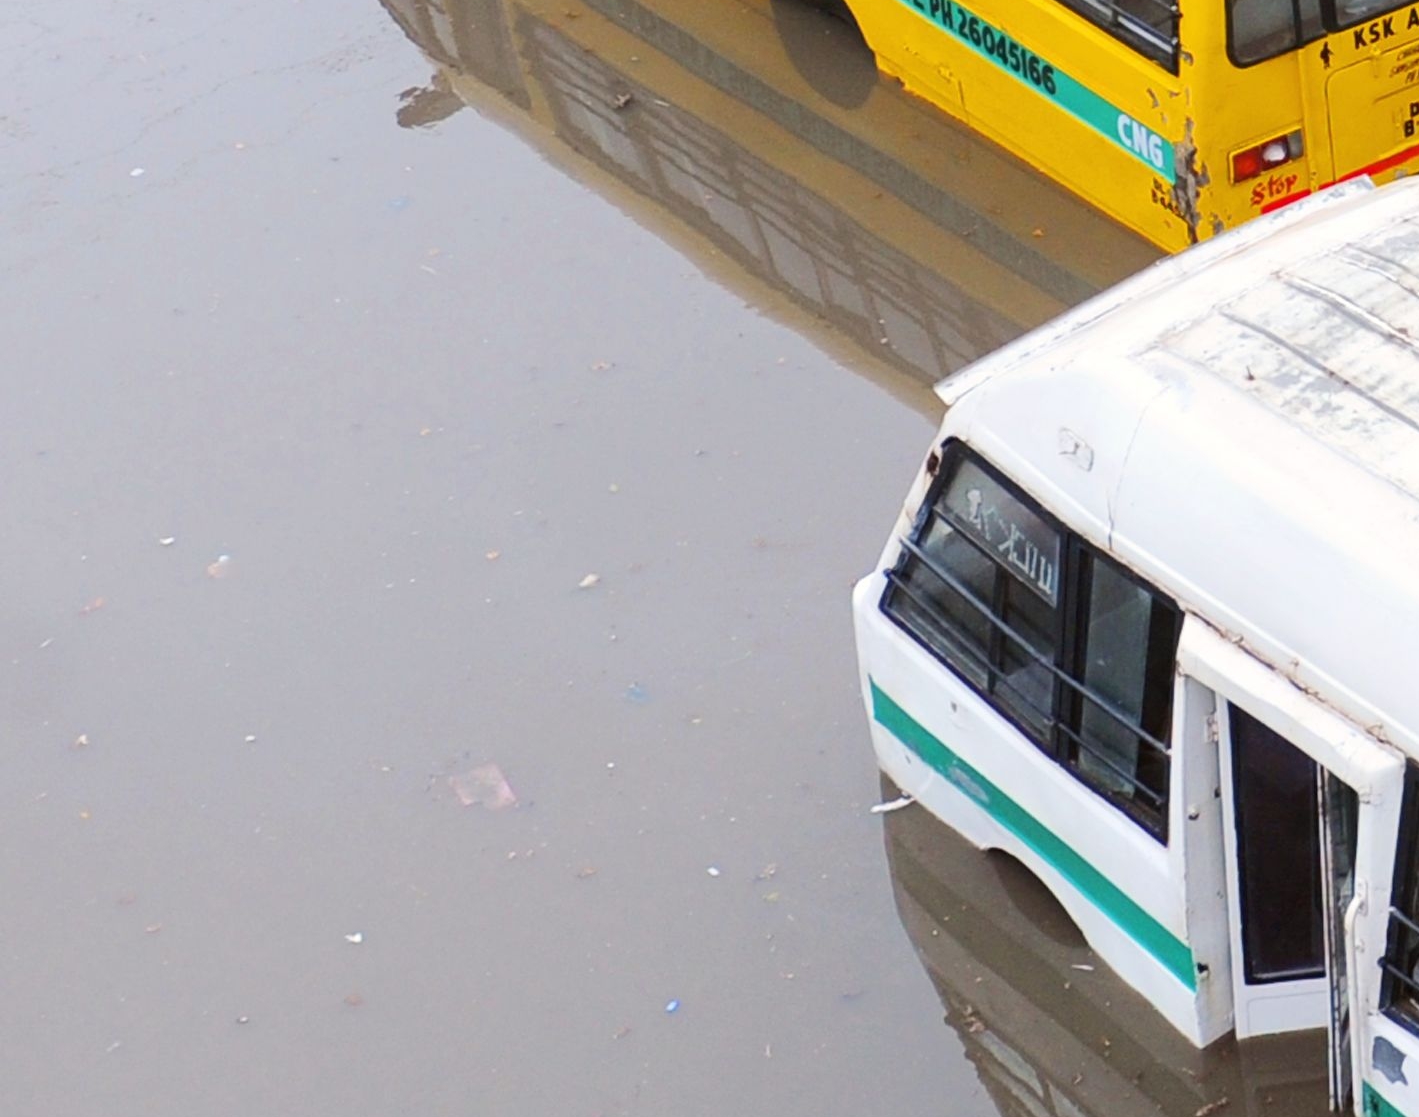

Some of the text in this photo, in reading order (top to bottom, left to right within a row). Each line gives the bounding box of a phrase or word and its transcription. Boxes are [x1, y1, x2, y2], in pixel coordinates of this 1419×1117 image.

[957, 8, 1057, 95] 26045166
[1353, 16, 1396, 50] KSK
[1116, 113, 1164, 169] CNG
[1250, 173, 1298, 207] Stop
